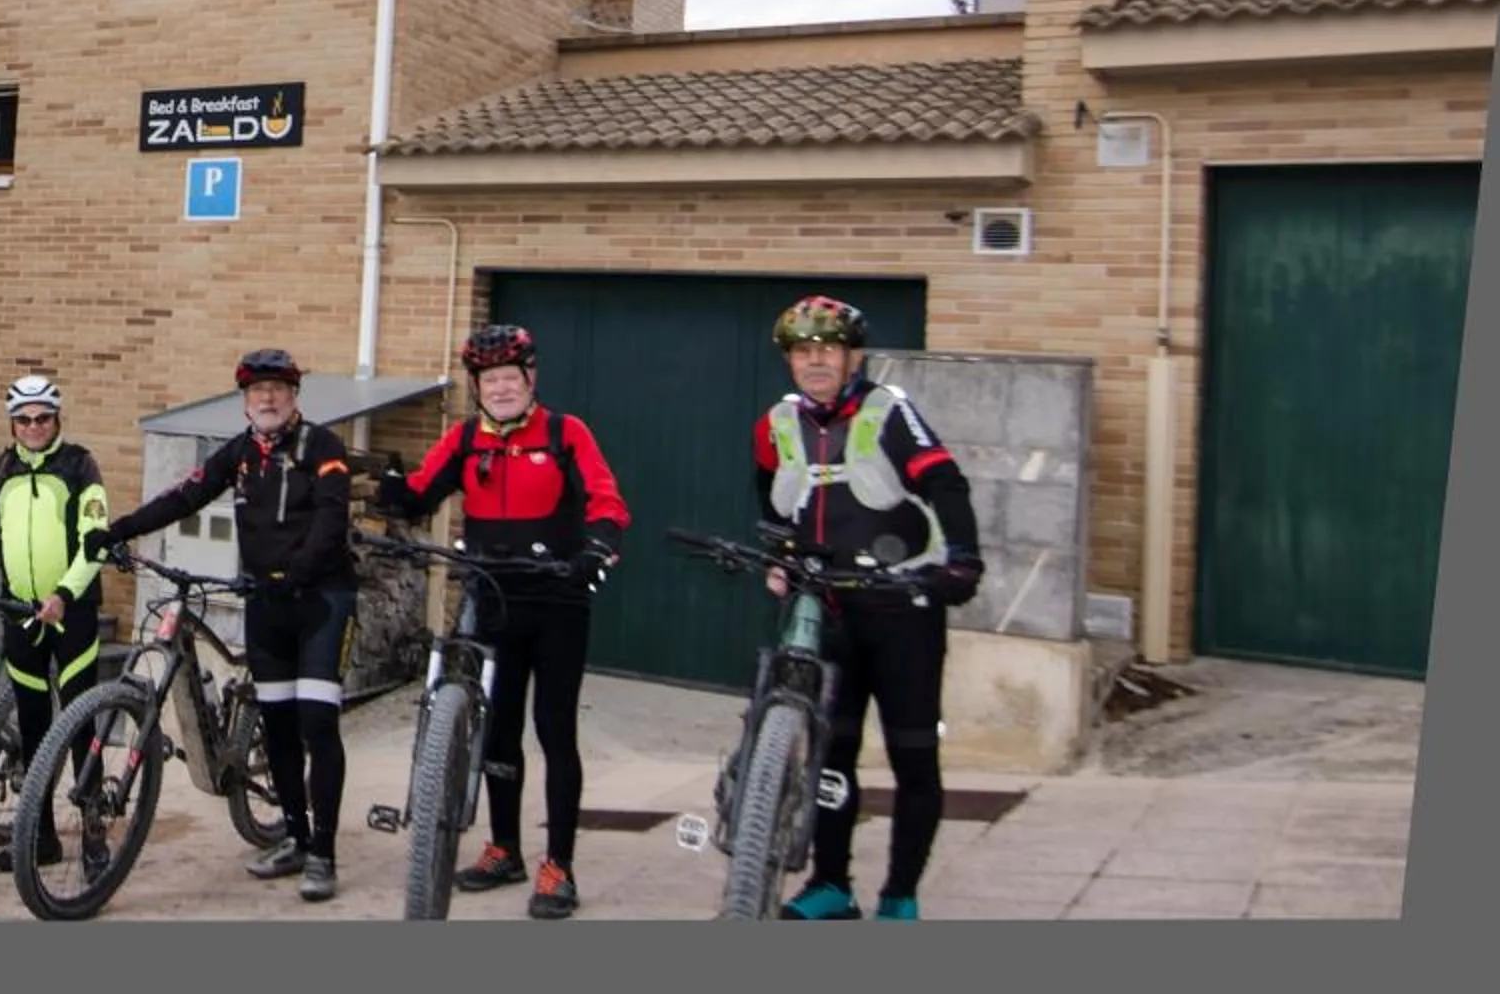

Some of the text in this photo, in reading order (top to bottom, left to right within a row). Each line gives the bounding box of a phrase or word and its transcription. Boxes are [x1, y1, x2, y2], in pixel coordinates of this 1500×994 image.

[149, 95, 261, 115] Bed & Breakfast
[147, 113, 293, 144] ZALDU
[203, 166, 224, 197] P
